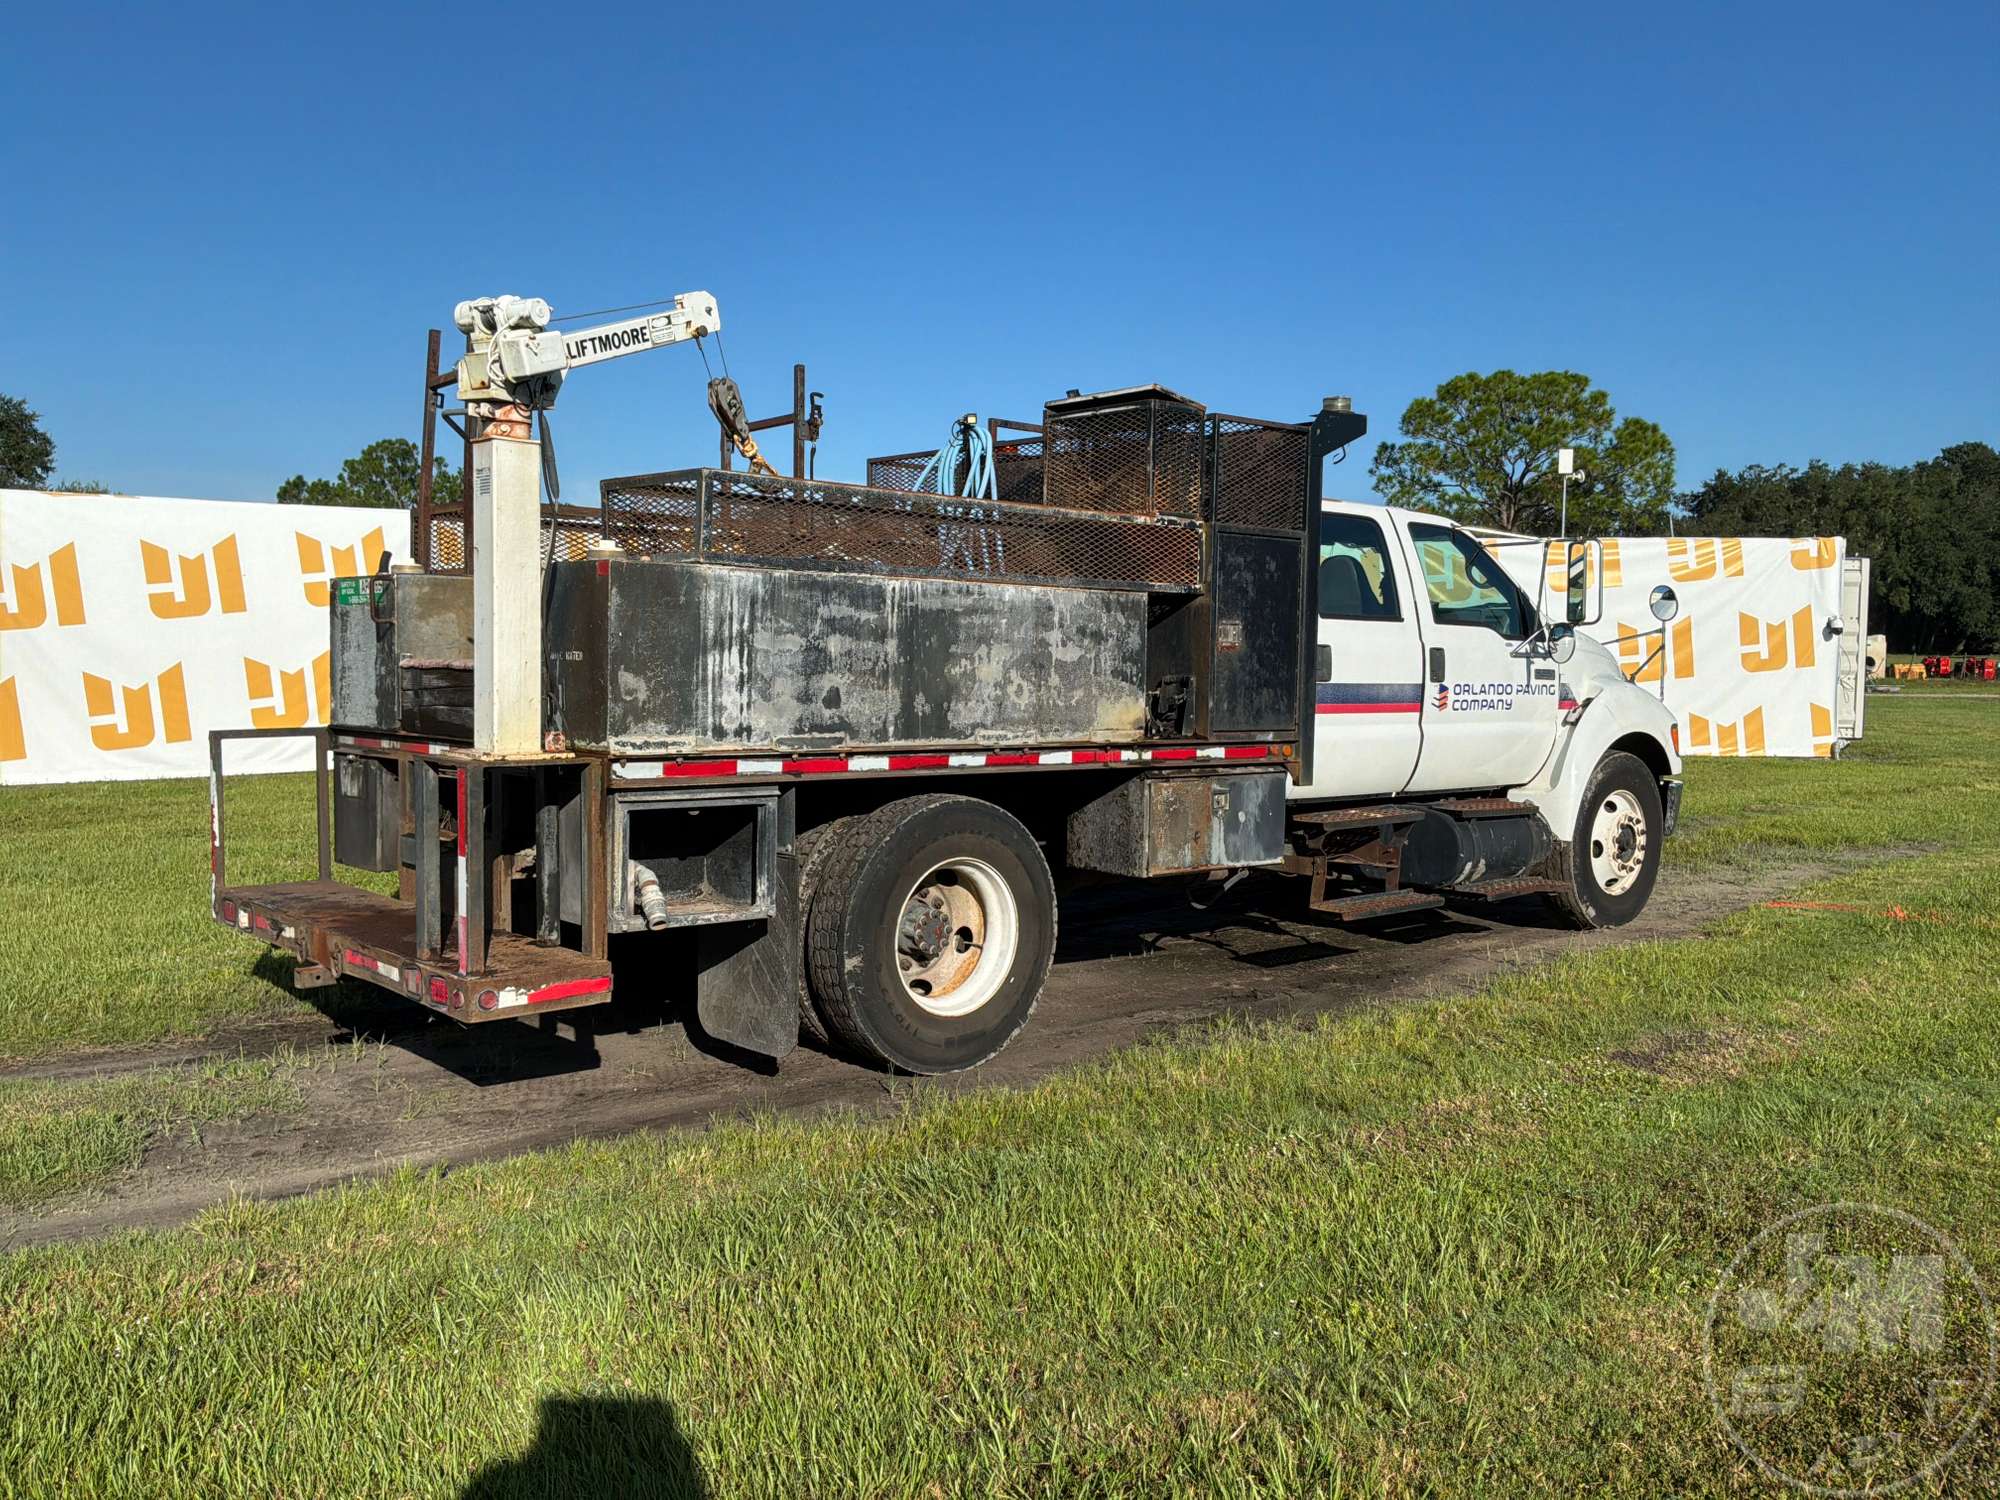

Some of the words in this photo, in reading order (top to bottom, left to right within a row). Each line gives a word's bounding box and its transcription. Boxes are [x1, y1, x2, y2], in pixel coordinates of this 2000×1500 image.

[566, 326, 650, 359] LIFTMOORE
[1453, 683, 1513, 696] ORLANDO
[1516, 684, 1556, 696] PAVING
[1452, 699, 1513, 711] COMPANY
